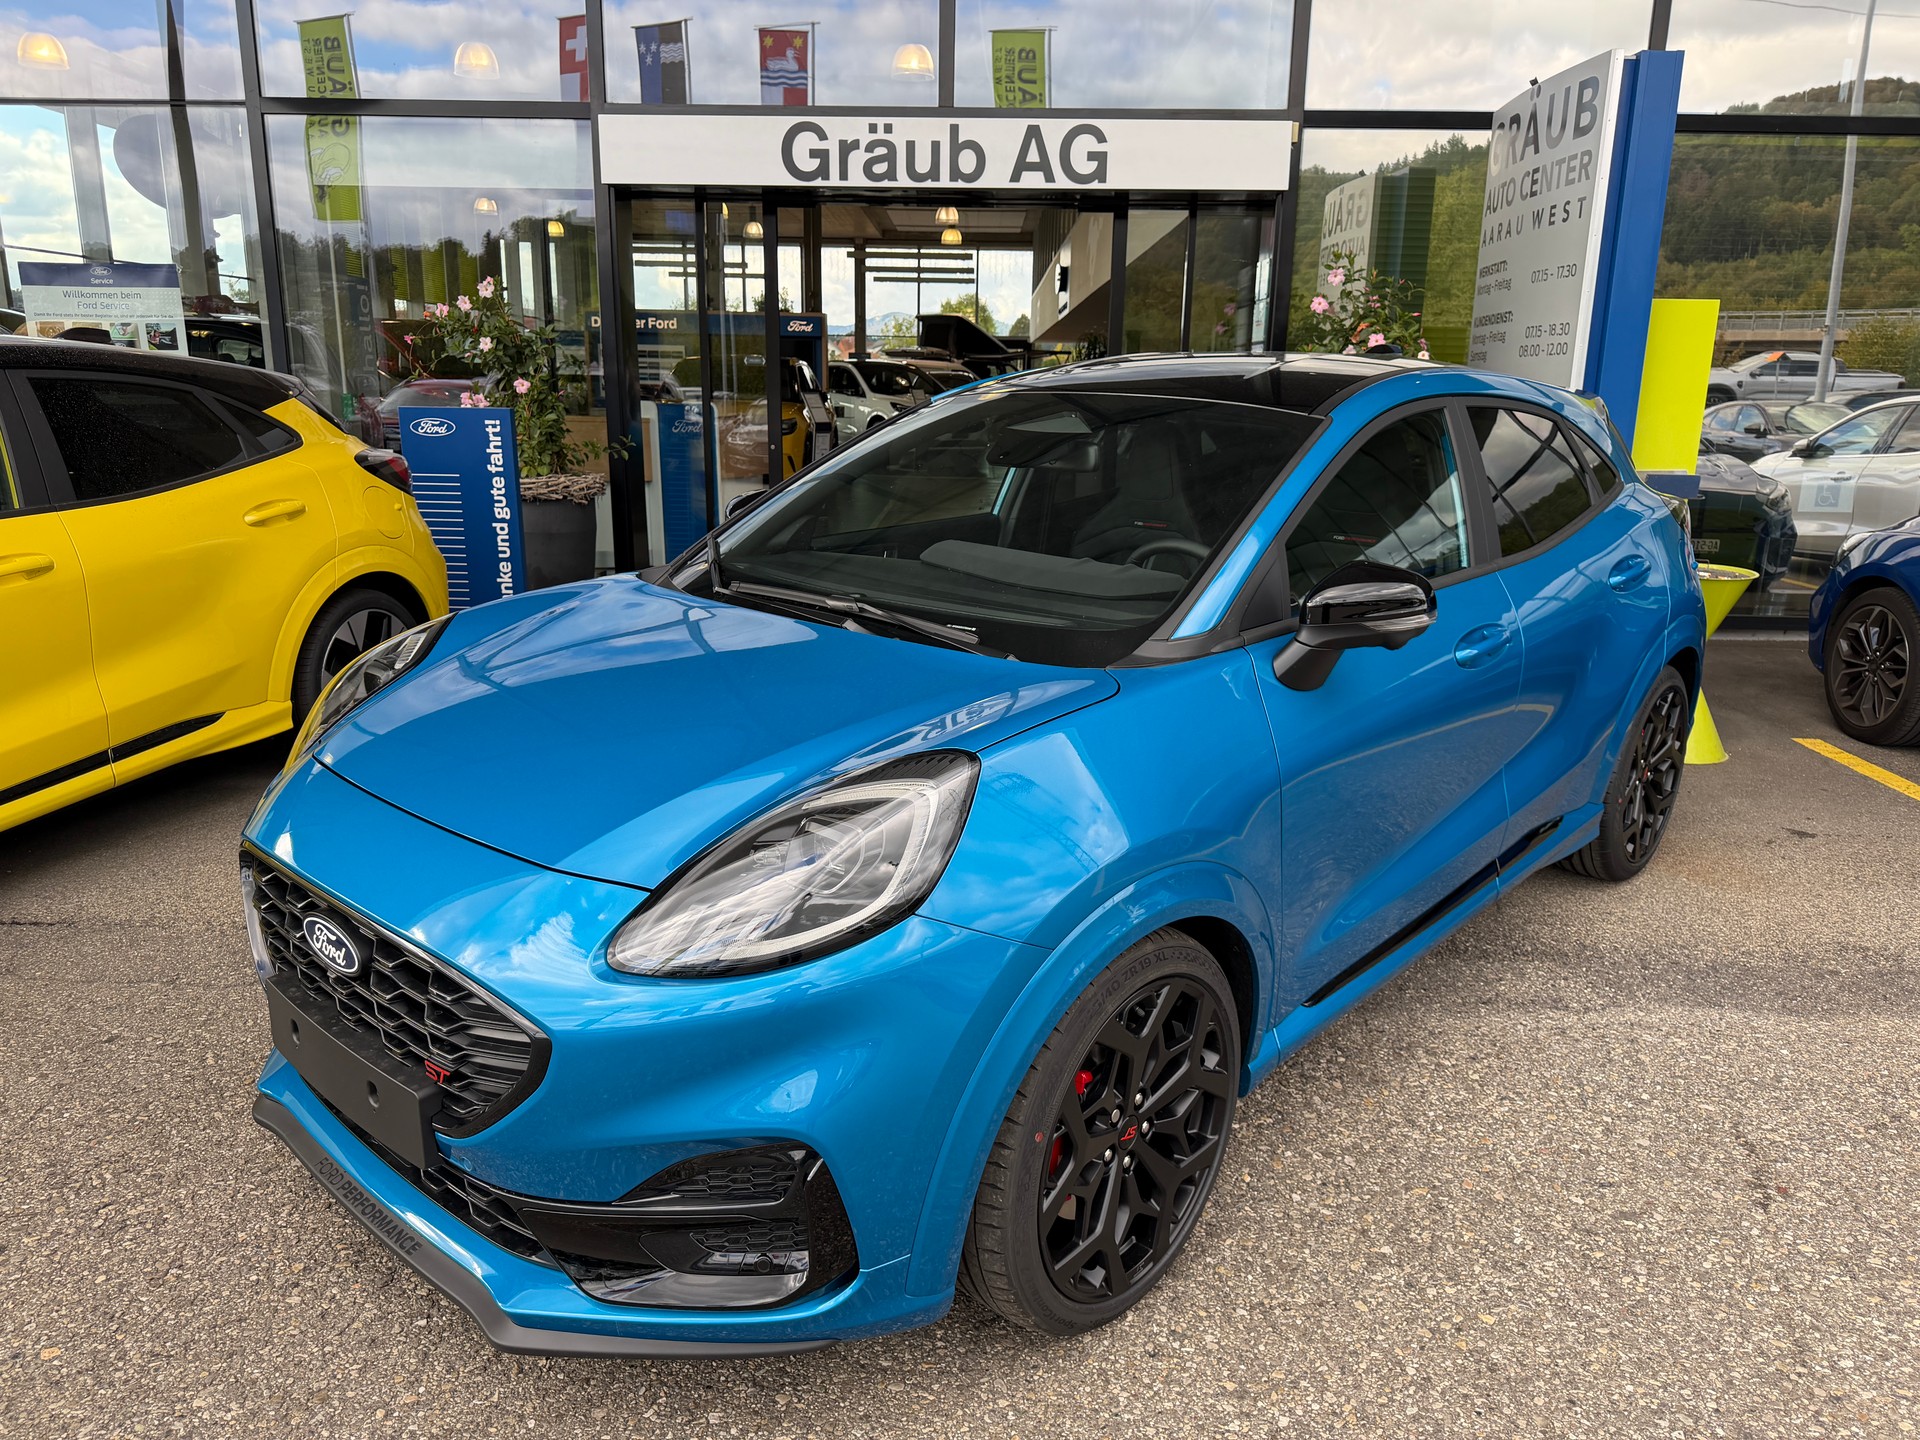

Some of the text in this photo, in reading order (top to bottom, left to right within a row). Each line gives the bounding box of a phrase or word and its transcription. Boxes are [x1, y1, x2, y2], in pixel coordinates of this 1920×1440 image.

[1490, 75, 1600, 177] GRÄUB
[781, 121, 1108, 185] Gräub AG
[1484, 149, 1592, 217] AUTO CENTER
[1481, 196, 1586, 248] AARAU WEST
[1557, 263, 1577, 279] 17.30
[62, 290, 142, 300] Willkommen beim
[77, 301, 130, 310] Ford Service
[648, 317, 677, 329] Ford
[787, 320, 814, 333] Ford
[1549, 322, 1570, 336] 18.30
[1519, 344, 1540, 357] 08.00
[1546, 342, 1568, 356] 12.00
[418, 420, 447, 434] Ford
[484, 419, 504, 473] fahrt!
[490, 476, 511, 520] gute
[492, 523, 509, 558] und
[313, 924, 346, 966] Ford
[424, 1060, 450, 1084] ST
[314, 1157, 423, 1256] FORD PERFORMANCE
